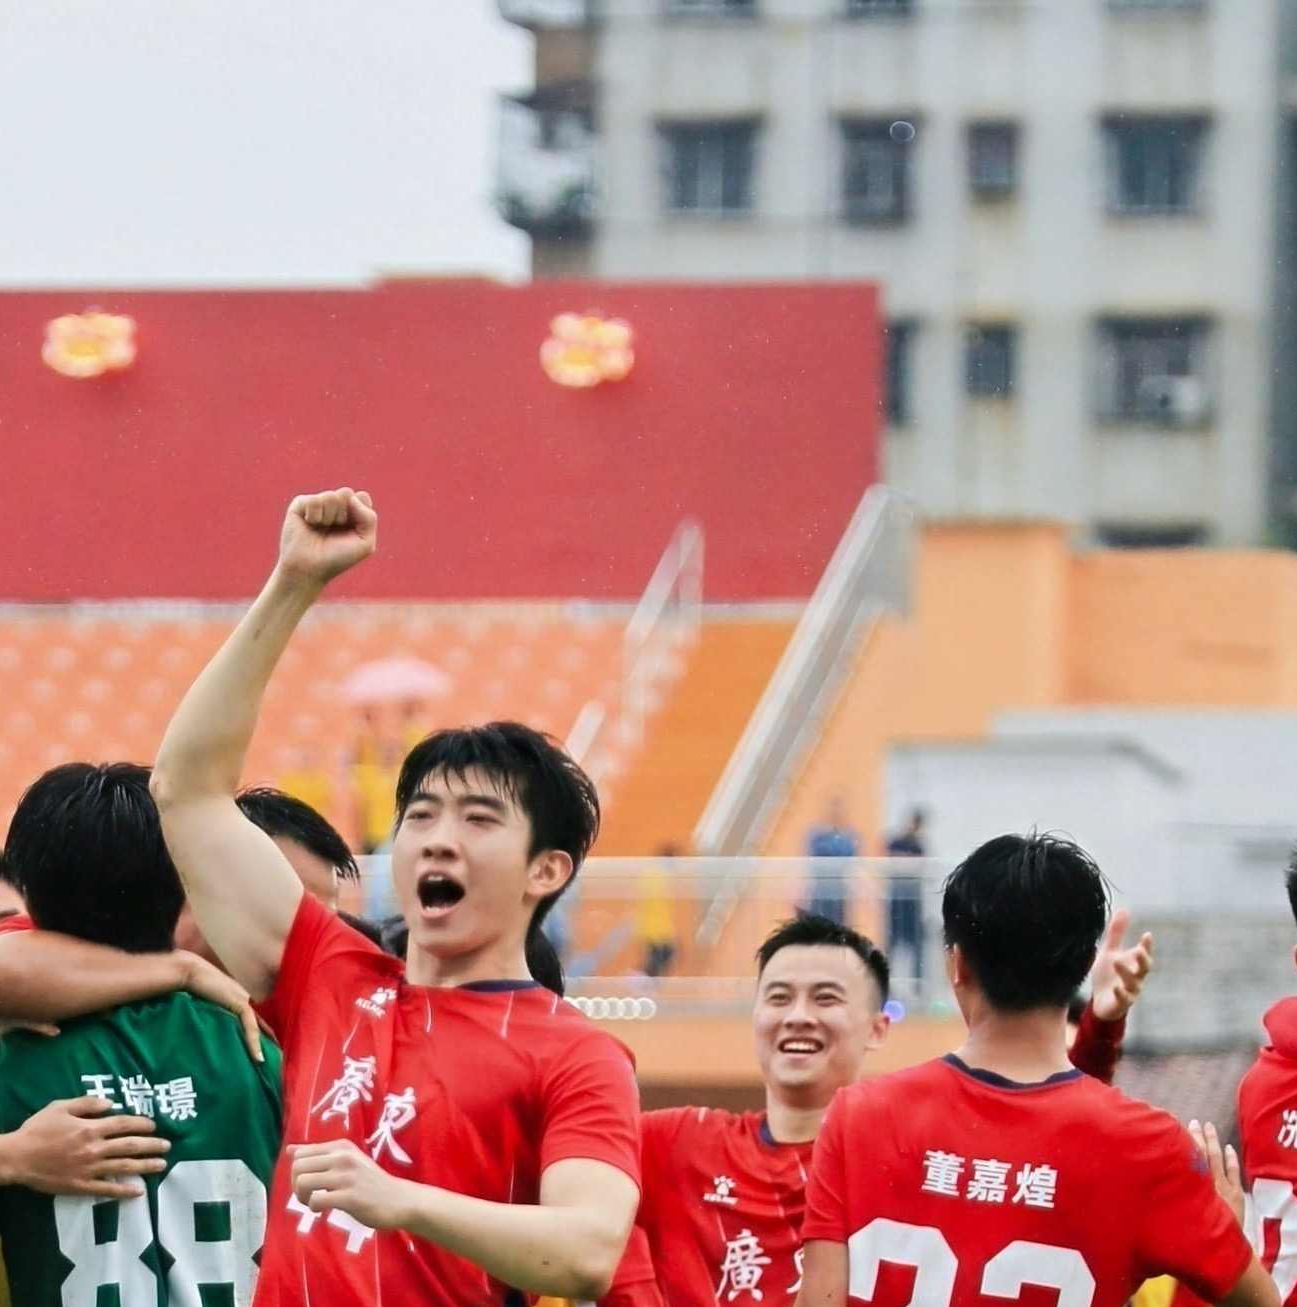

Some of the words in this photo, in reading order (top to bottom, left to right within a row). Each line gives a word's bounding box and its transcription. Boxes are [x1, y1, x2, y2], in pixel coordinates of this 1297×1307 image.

[80, 1074, 198, 1120] 王瑞璟
[921, 1150, 1058, 1208] 董嘉煌
[714, 1228, 805, 1301] 廣
